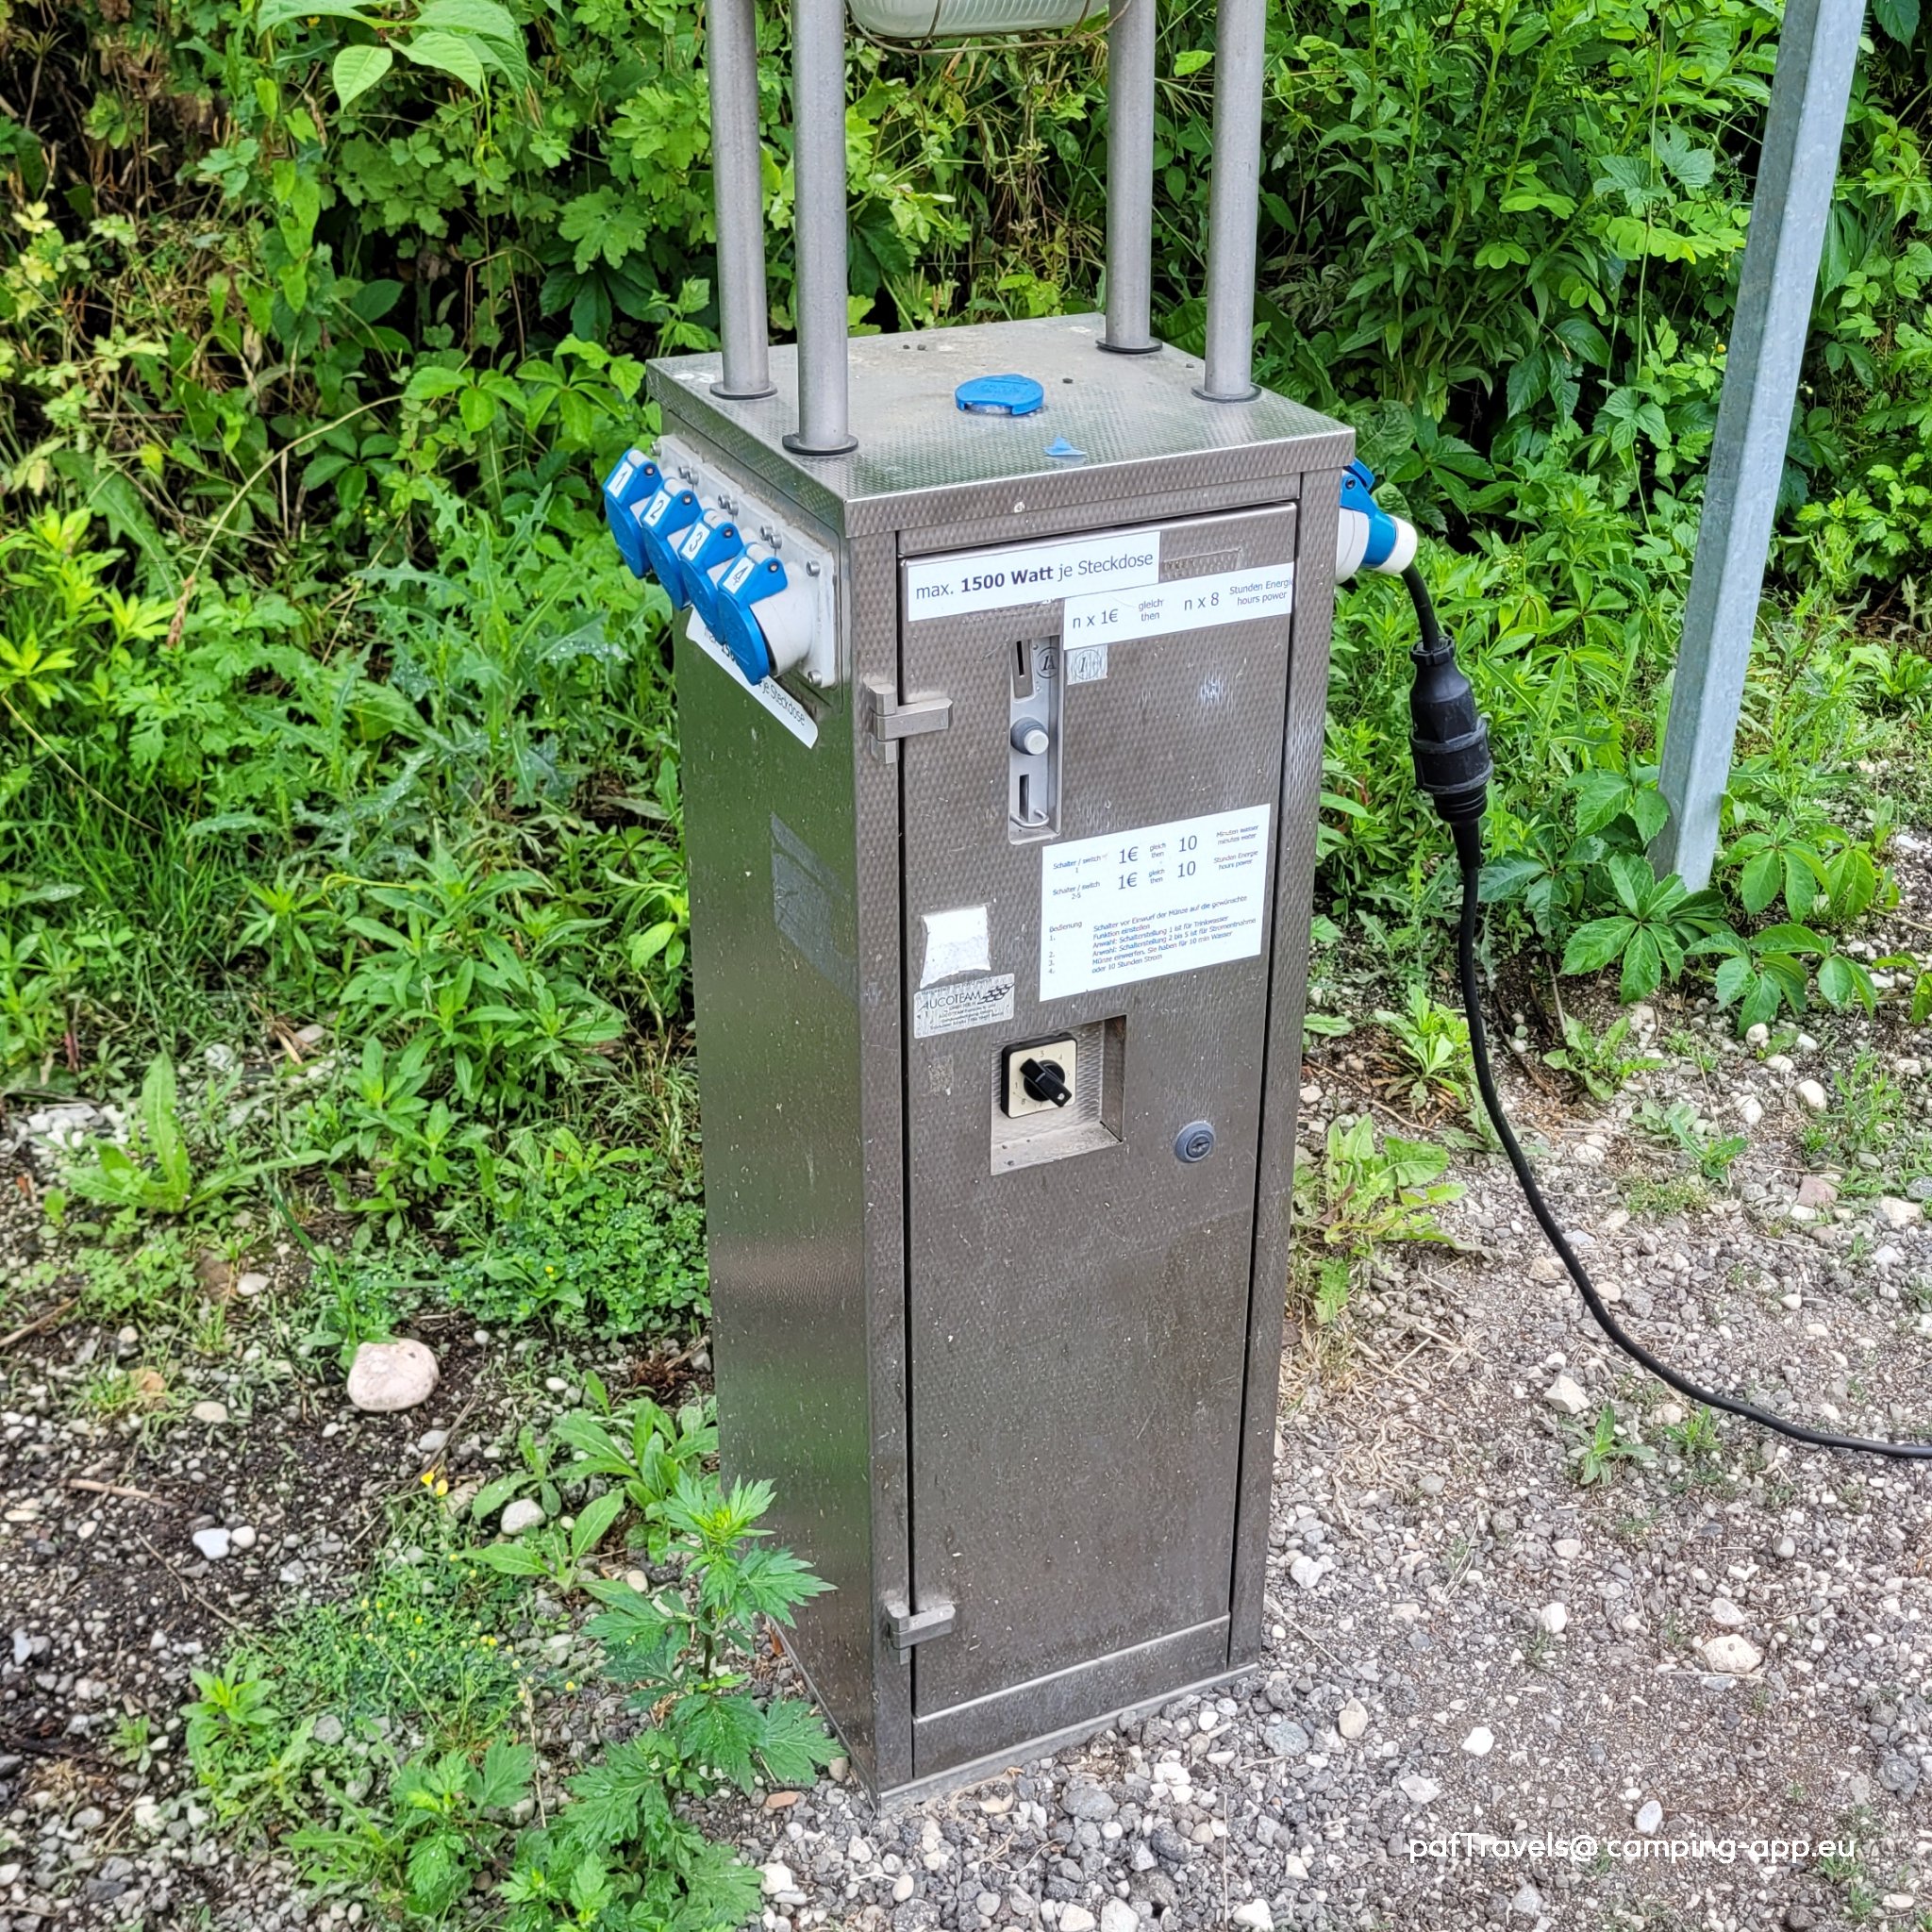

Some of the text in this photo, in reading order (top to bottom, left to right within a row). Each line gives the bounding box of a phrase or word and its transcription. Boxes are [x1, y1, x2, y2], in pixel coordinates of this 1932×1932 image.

[650, 499, 664, 521] 2
[689, 531, 704, 552] 3
[731, 566, 749, 587] 4
[916, 553, 1154, 599] max. 1500 Watt je Steckdose
[1229, 582, 1263, 595] Stunden
[1138, 598, 1164, 612] gleich
[1184, 591, 1220, 610] n x 8
[1237, 591, 1287, 607] hours power
[1073, 608, 1119, 629] n x 1€
[1141, 610, 1160, 622] then
[770, 684, 806, 725] Steckdose
[1178, 835, 1198, 853] 10
[1119, 846, 1139, 864] 1€
[1236, 859, 1253, 868] power
[1053, 860, 1076, 869] Schalter
[1177, 860, 1196, 878] 10
[1118, 872, 1138, 890] 1€
[1093, 923, 1119, 932] Schalter
[918, 991, 981, 1011] AUCOTEAM
